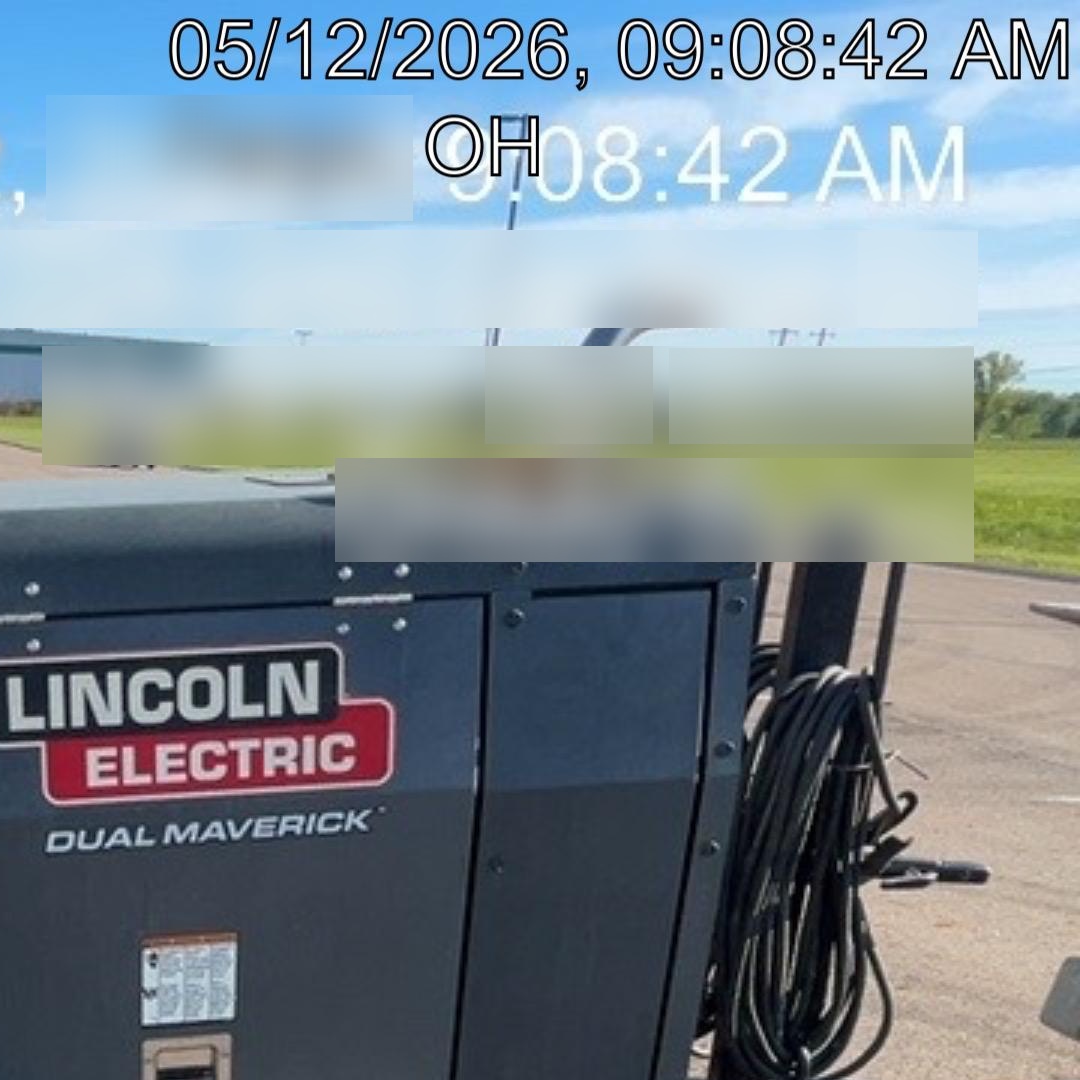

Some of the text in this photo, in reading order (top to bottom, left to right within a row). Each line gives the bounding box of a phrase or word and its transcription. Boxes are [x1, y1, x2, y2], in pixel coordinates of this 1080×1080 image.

[6, 659, 320, 733] LINCOLN
[85, 732, 357, 788] ELECTRIC
[45, 808, 372, 854] DUAL MAVERICK
